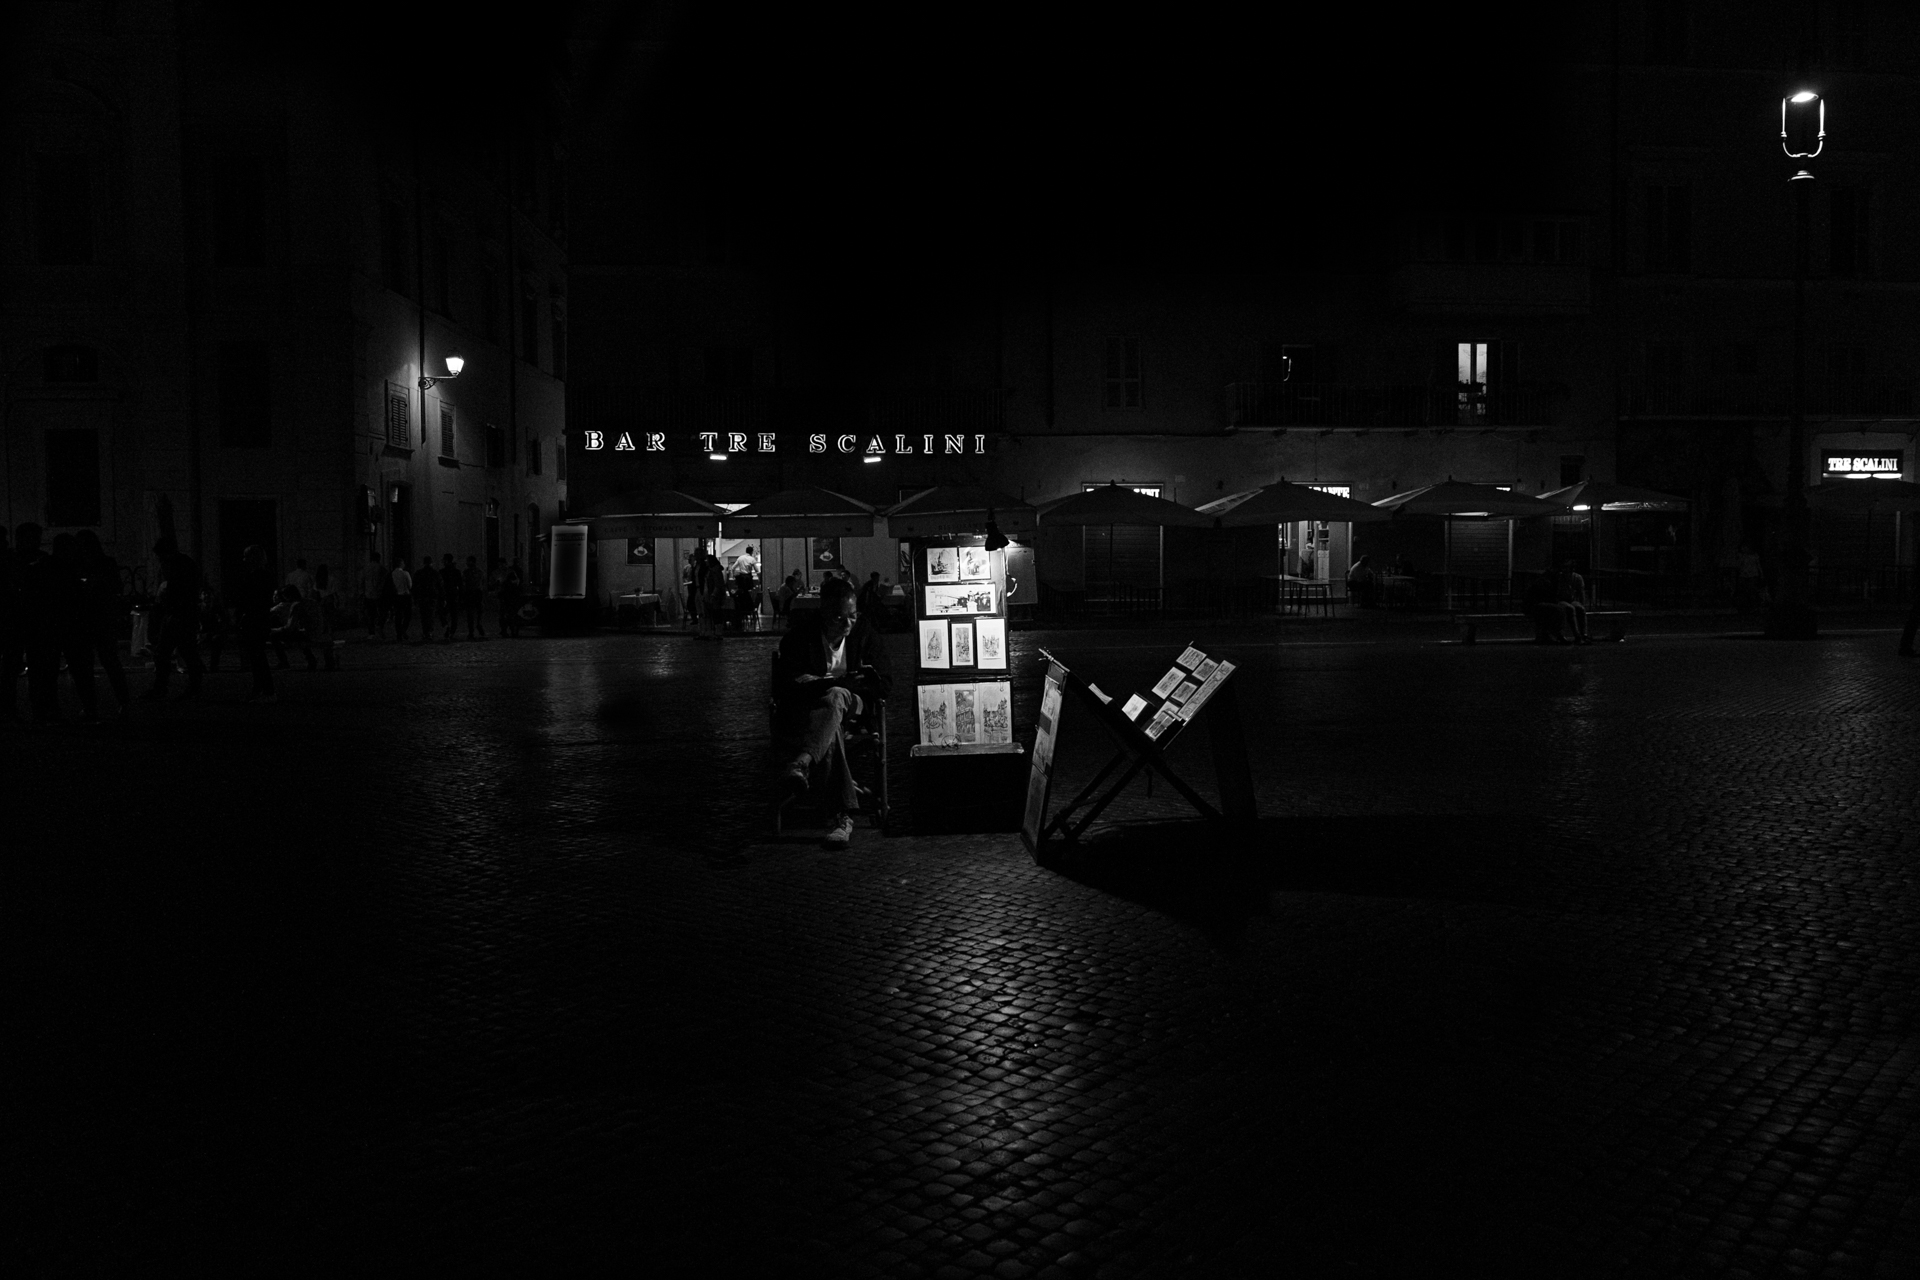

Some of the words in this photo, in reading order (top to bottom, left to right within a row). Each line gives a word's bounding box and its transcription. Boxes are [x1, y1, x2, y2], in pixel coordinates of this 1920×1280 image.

[584, 430, 666, 451] BAR
[699, 432, 776, 452] TRE
[809, 433, 986, 454] SCALINI
[1827, 457, 1852, 471] TRE
[1852, 457, 1899, 471] SCALINI
